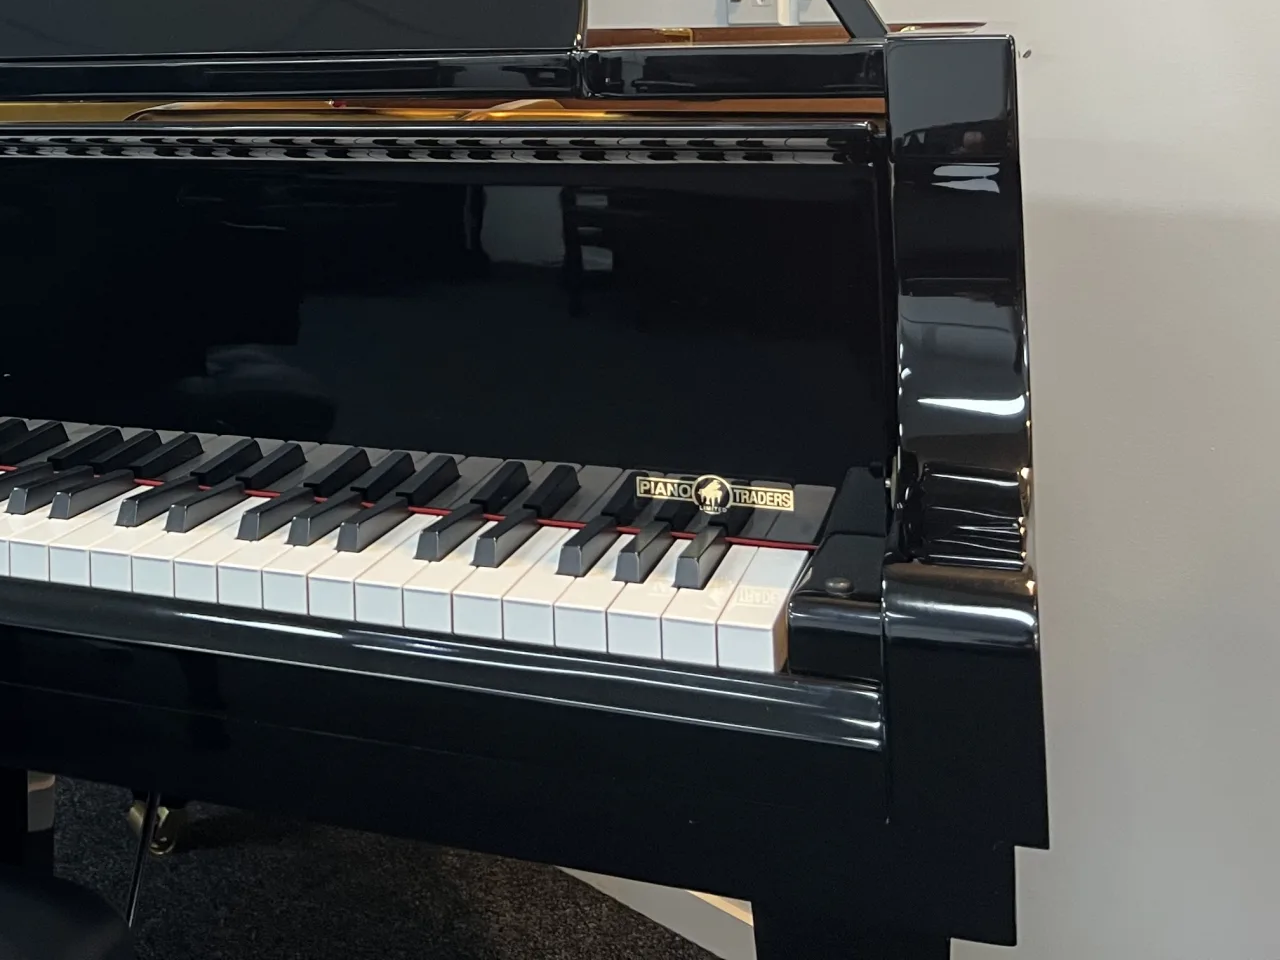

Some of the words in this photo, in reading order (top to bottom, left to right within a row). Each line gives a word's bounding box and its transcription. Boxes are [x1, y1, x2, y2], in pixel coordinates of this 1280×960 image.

[640, 480, 691, 498] PIANO
[734, 489, 791, 508] TRADERS
[699, 505, 727, 513] LIMITED
